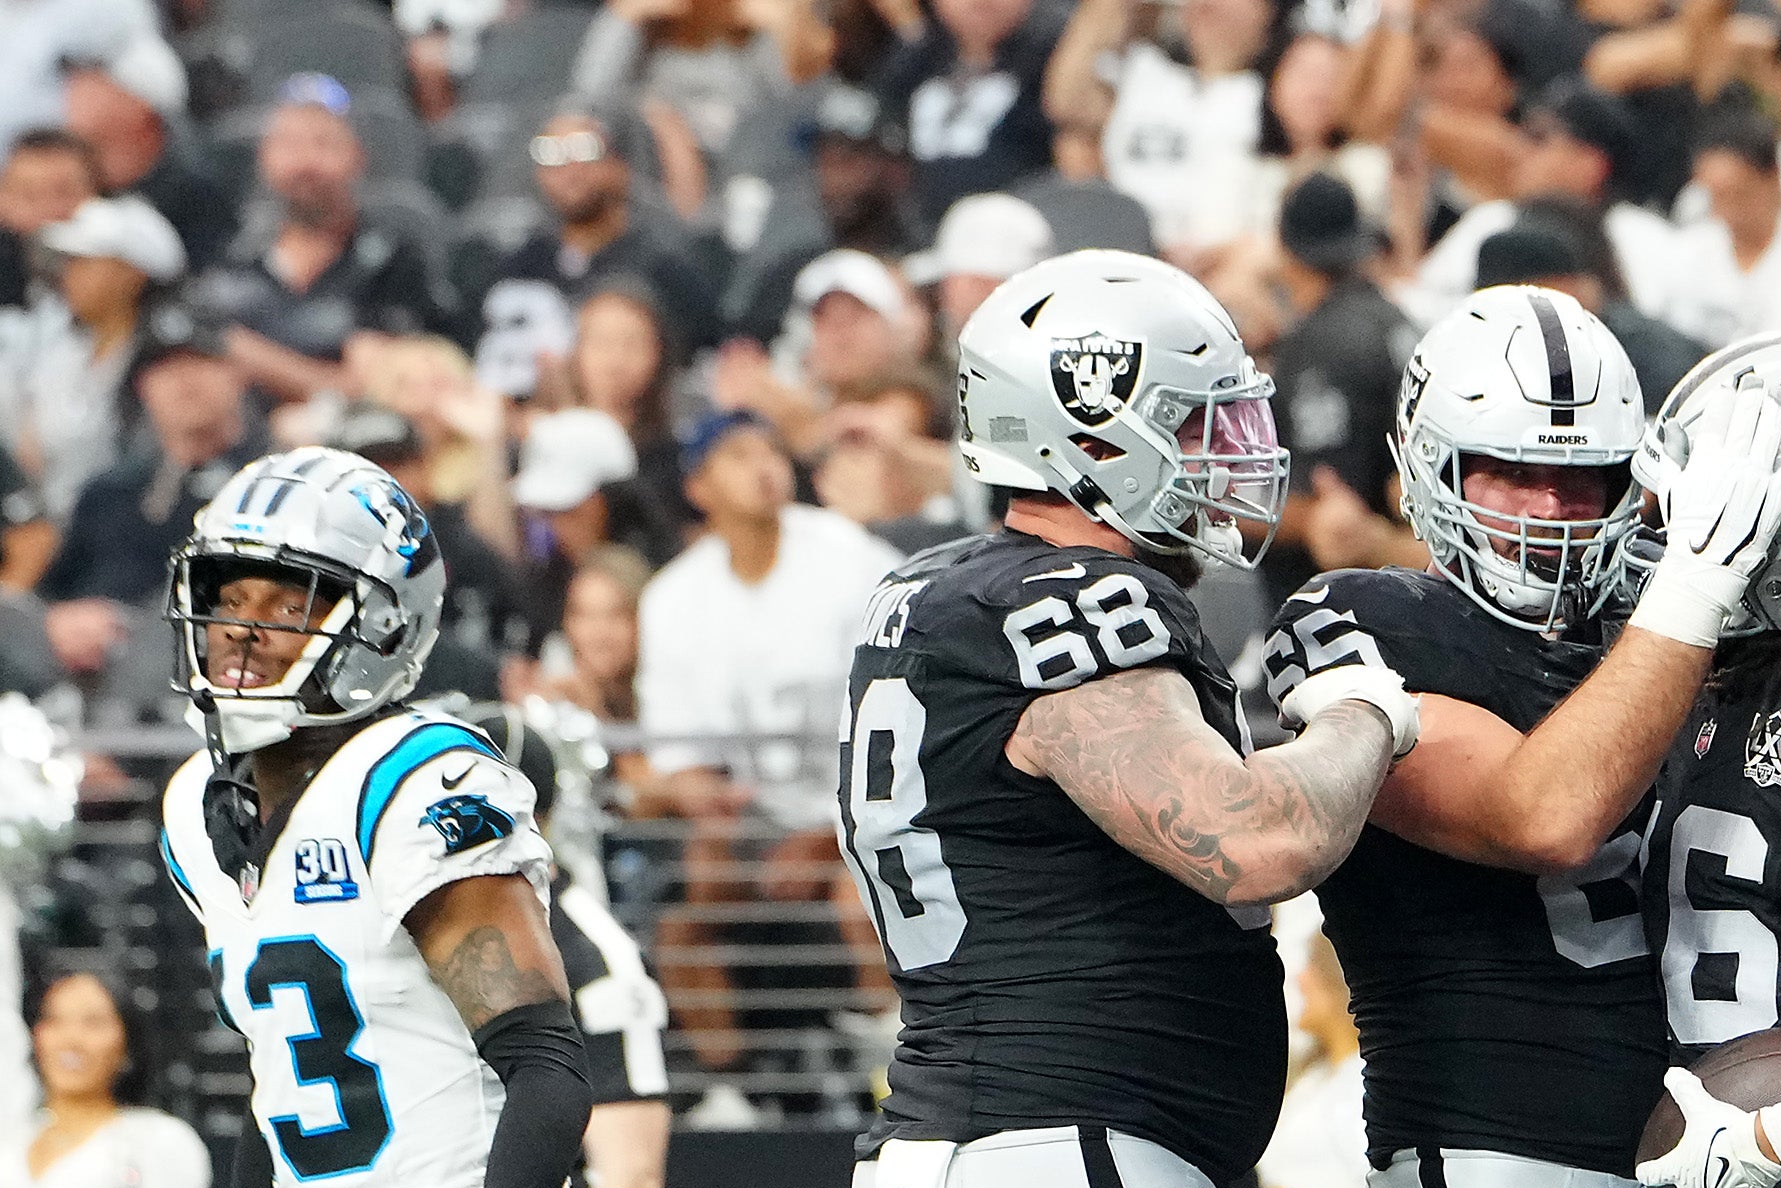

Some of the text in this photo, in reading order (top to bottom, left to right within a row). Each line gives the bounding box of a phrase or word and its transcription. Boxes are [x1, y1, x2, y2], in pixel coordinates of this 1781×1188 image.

[1538, 434, 1588, 445] RAIDERS
[1004, 574, 1171, 690] 68
[1261, 608, 1388, 712] 65
[296, 838, 351, 885] 30
